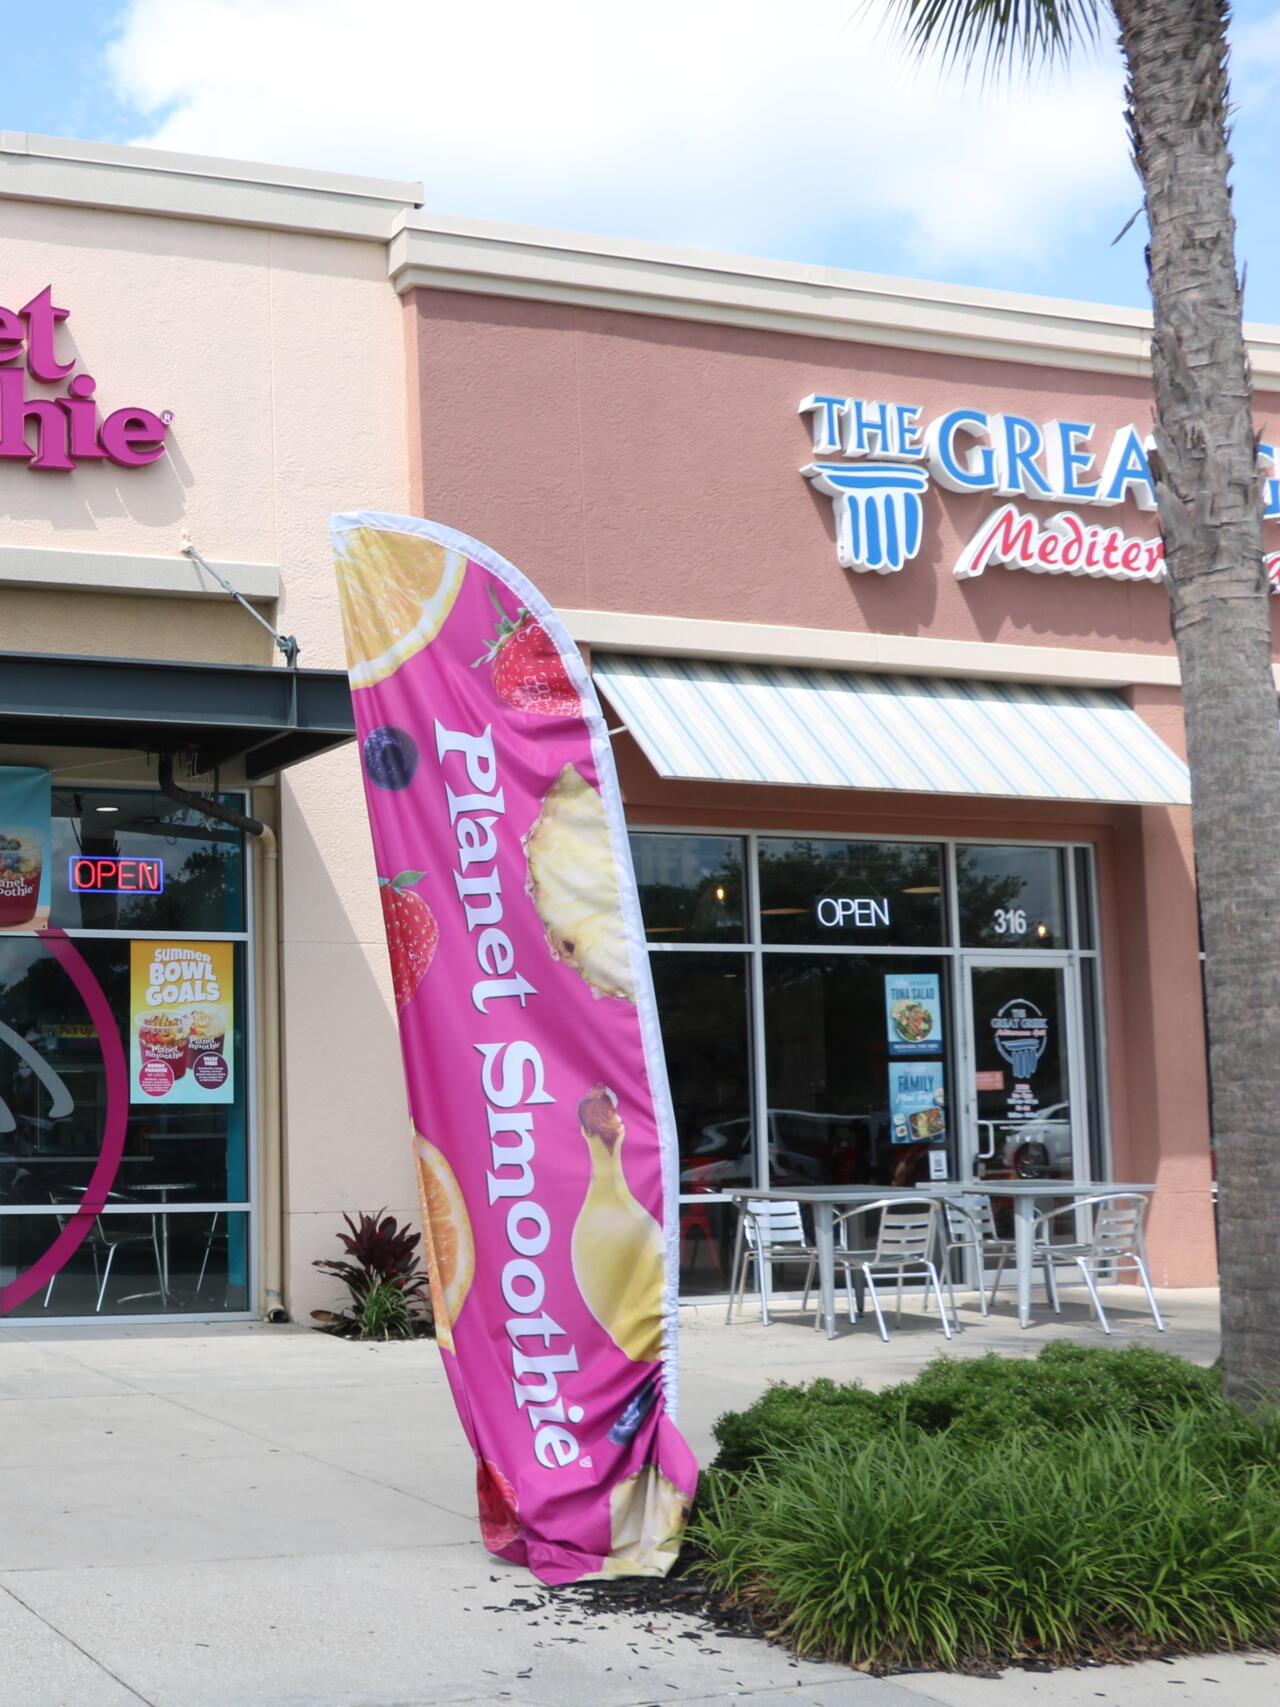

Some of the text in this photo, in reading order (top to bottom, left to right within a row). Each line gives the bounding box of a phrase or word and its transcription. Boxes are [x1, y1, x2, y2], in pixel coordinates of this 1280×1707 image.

[798, 393, 926, 463] THE
[927, 408, 1158, 511] GREA
[74, 860, 158, 890] OPEN
[433, 717, 539, 1015] Planet
[817, 898, 890, 926] OPEN
[993, 909, 1027, 934] 316
[149, 961, 217, 985] BOWL
[145, 981, 220, 1006] GOALS
[898, 1075, 934, 1092] FAMILY
[473, 1040, 585, 1470] Smoothie
